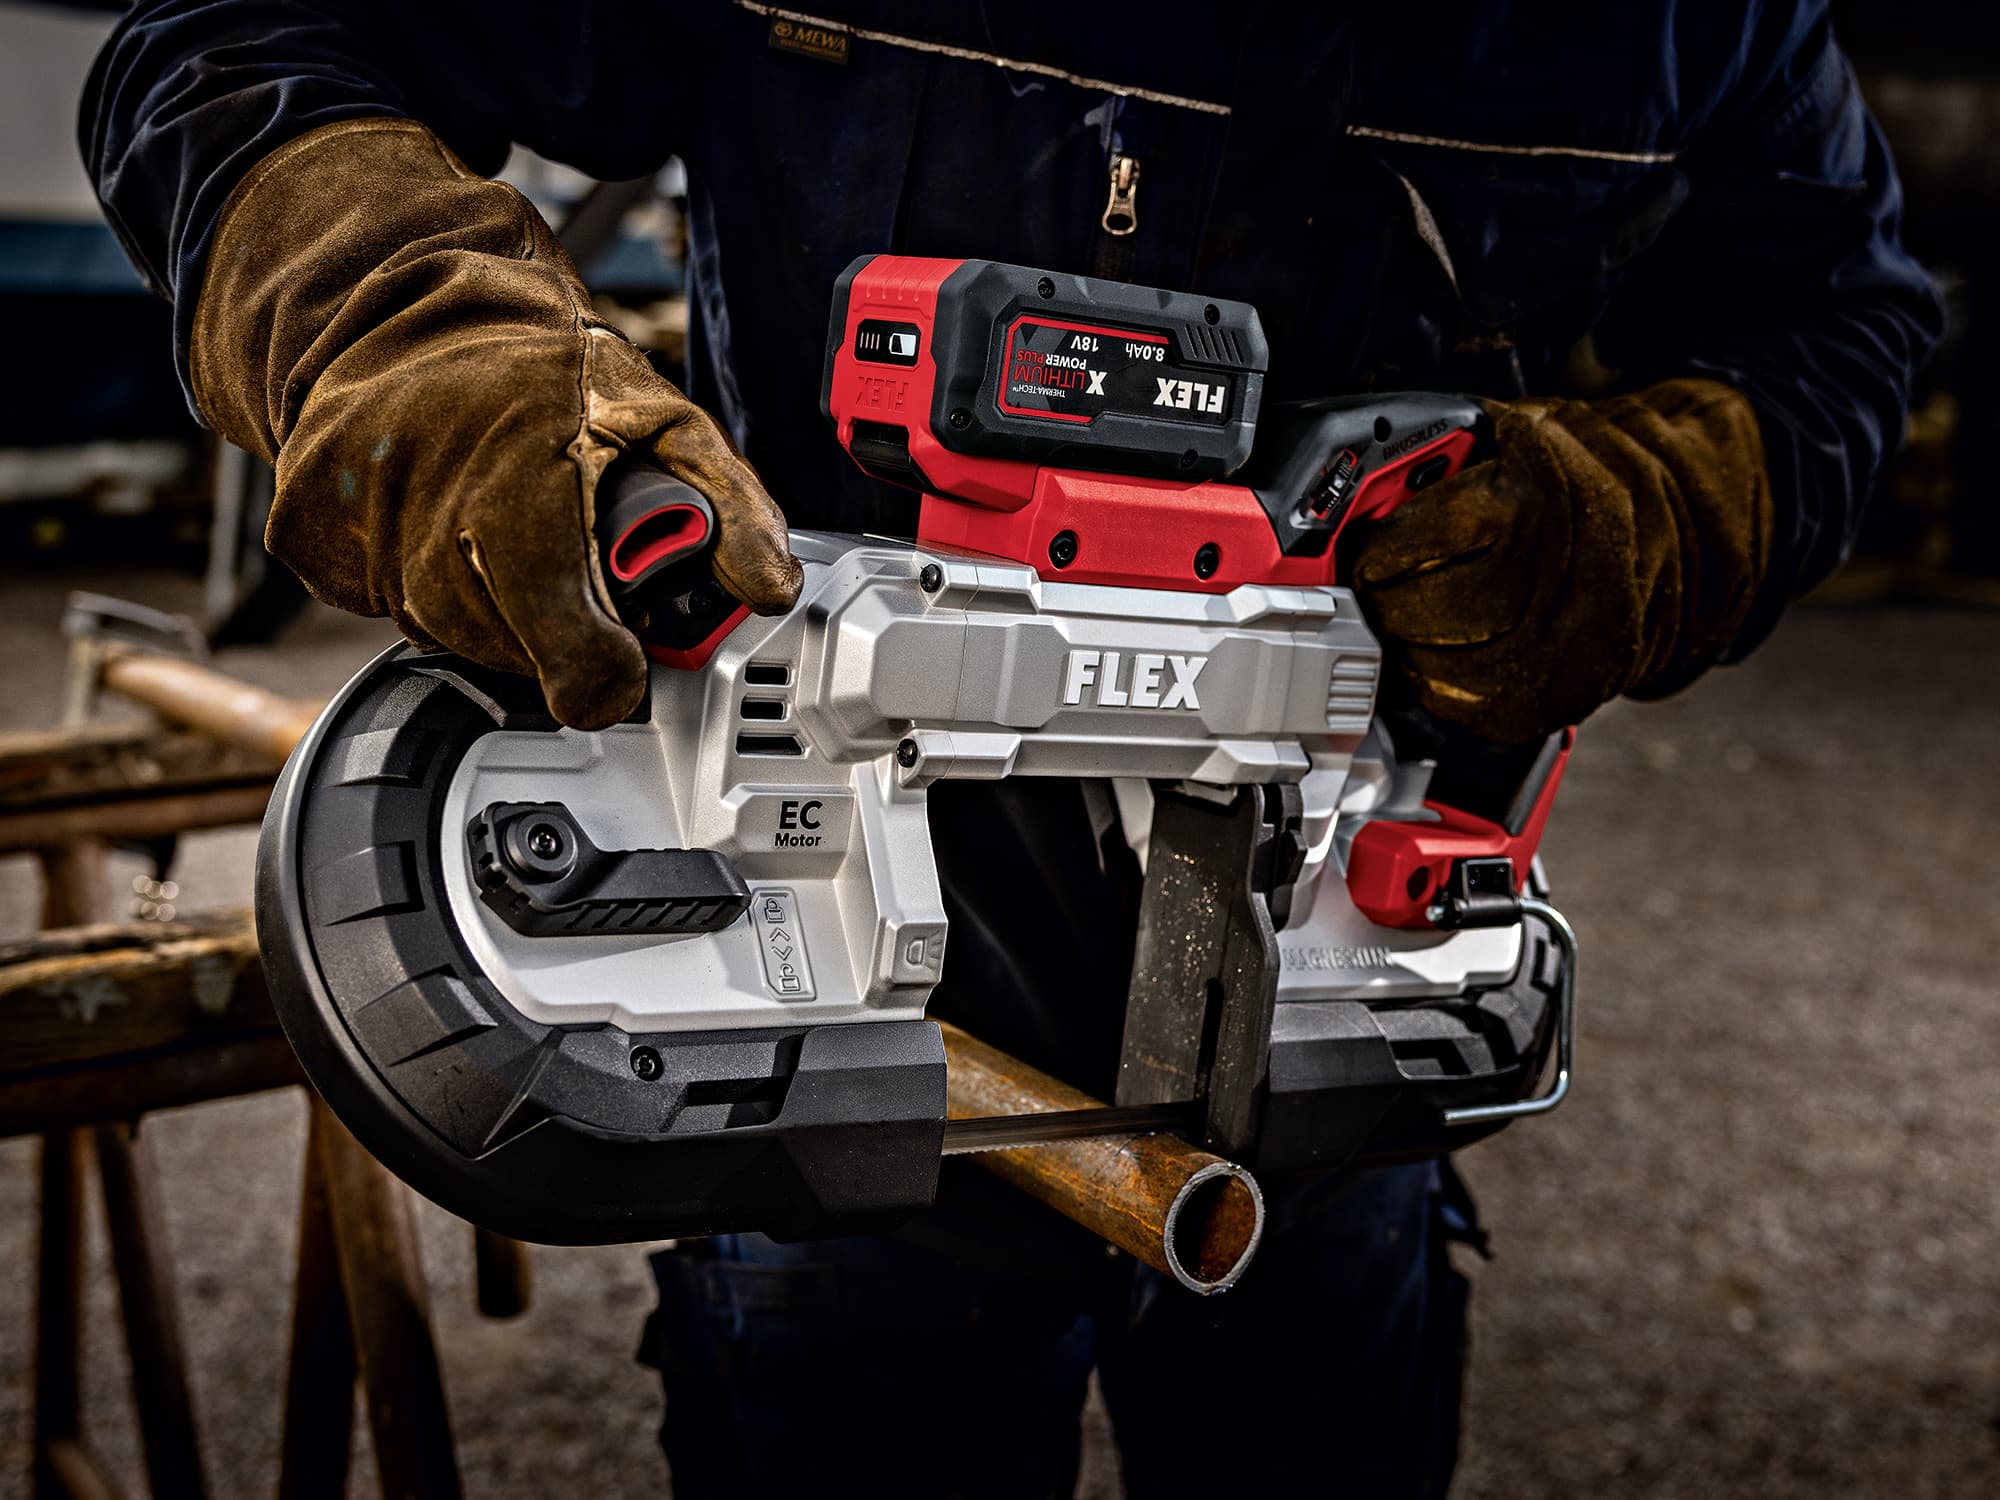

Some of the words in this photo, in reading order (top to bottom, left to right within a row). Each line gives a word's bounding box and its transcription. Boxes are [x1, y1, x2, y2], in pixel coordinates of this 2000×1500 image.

[795, 28, 847, 52] MEWA
[1017, 349, 1045, 364] PLUS
[1071, 335, 1099, 353] 18V
[1125, 342, 1165, 362] 8.0Ah
[1045, 353, 1087, 370] POWER
[1010, 363, 1086, 390] LITHIUM
[1085, 369, 1108, 396] X
[855, 376, 909, 413] FLEX
[1152, 377, 1225, 414] FLEX
[1063, 650, 1208, 709] FLEX
[779, 800, 823, 831] EC
[775, 832, 822, 847] Motor
